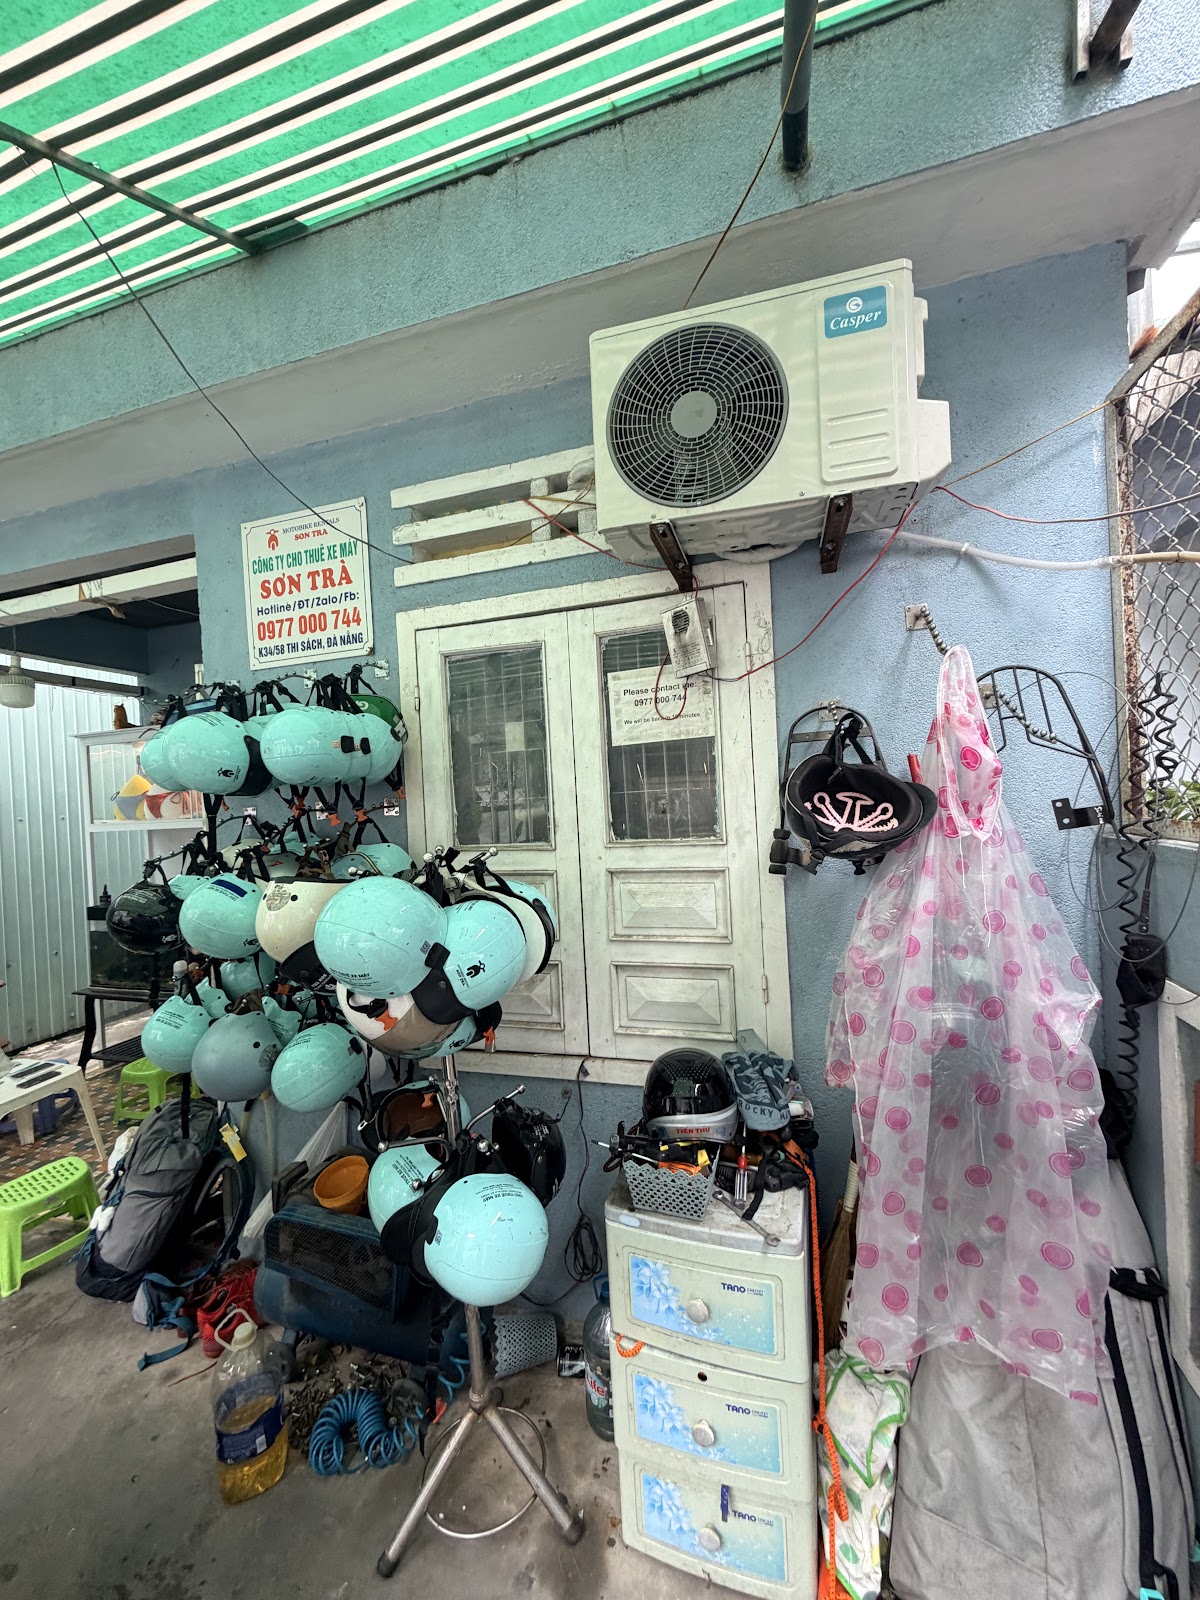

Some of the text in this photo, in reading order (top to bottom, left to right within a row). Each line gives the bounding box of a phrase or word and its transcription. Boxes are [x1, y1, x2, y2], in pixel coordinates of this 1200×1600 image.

[830, 310, 881, 328] Casper
[282, 522, 313, 534] MOTOBIKE
[294, 529, 328, 541] SON TRA
[252, 538, 358, 575] CÔNG TY CHO THUÊ XE MÁY
[260, 559, 353, 599] SƠN TRÀ
[257, 607, 361, 641] 0977 000 744
[258, 644, 285, 657] K34/58
[287, 642, 299, 653] THI
[300, 636, 325, 650] SÁCH,
[327, 634, 338, 647] ĐÀ
[624, 687, 649, 696] Please
[651, 682, 680, 693] contact
[634, 698, 652, 706] 0977
[656, 696, 669, 704] 000
[738, 1099, 774, 1118] ROCKY
[721, 1282, 746, 1293] TANO
[726, 1404, 750, 1415] TANO
[732, 1510, 757, 1522] TANO
